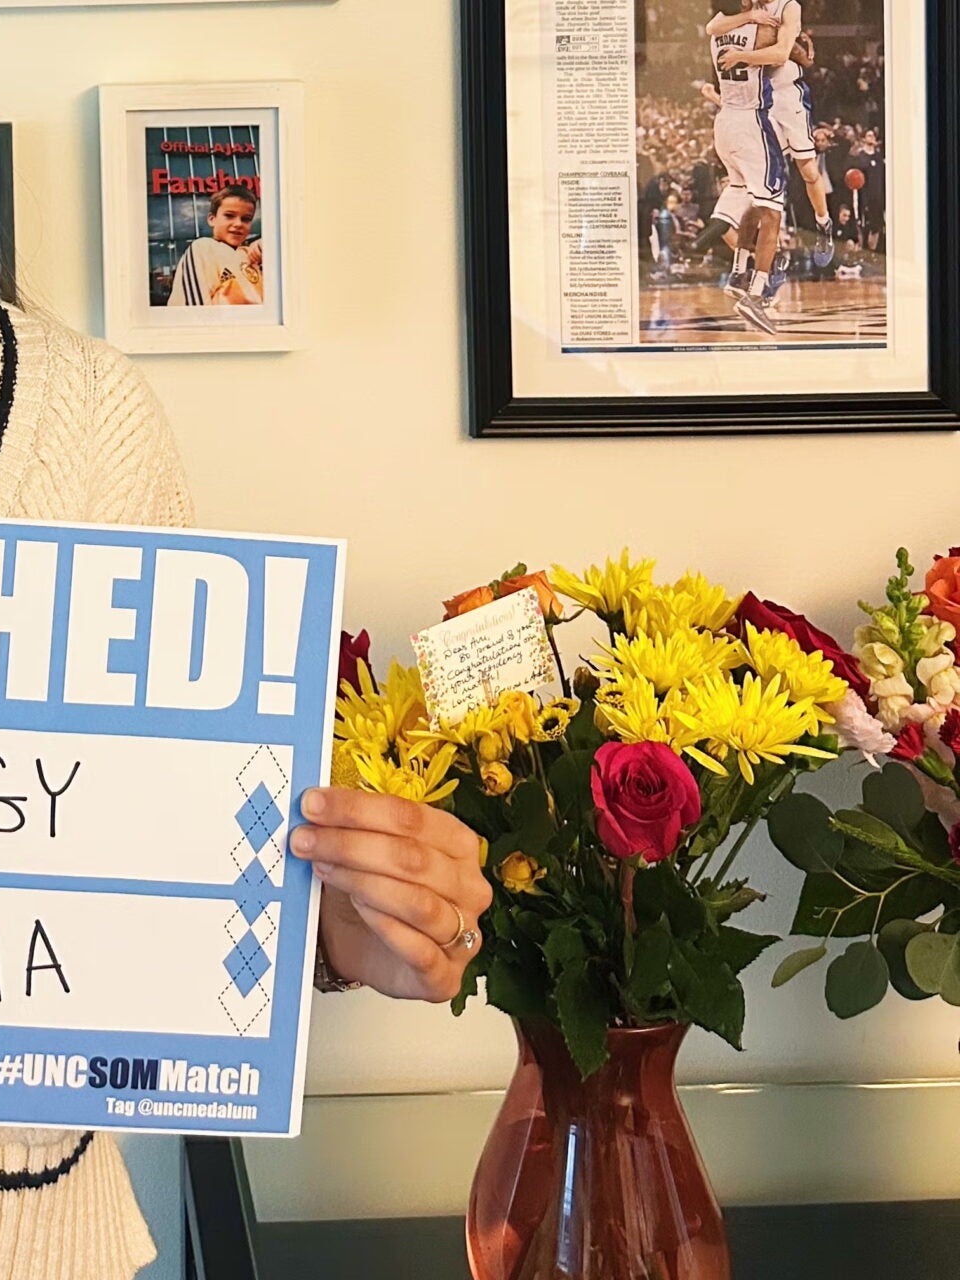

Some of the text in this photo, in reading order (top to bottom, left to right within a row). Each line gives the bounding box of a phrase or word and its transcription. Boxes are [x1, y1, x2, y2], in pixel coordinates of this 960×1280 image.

[714, 34, 748, 48] THOMAS
[160, 141, 209, 153] Official
[105, 1096, 258, 1120] Tag @uncmedalum
